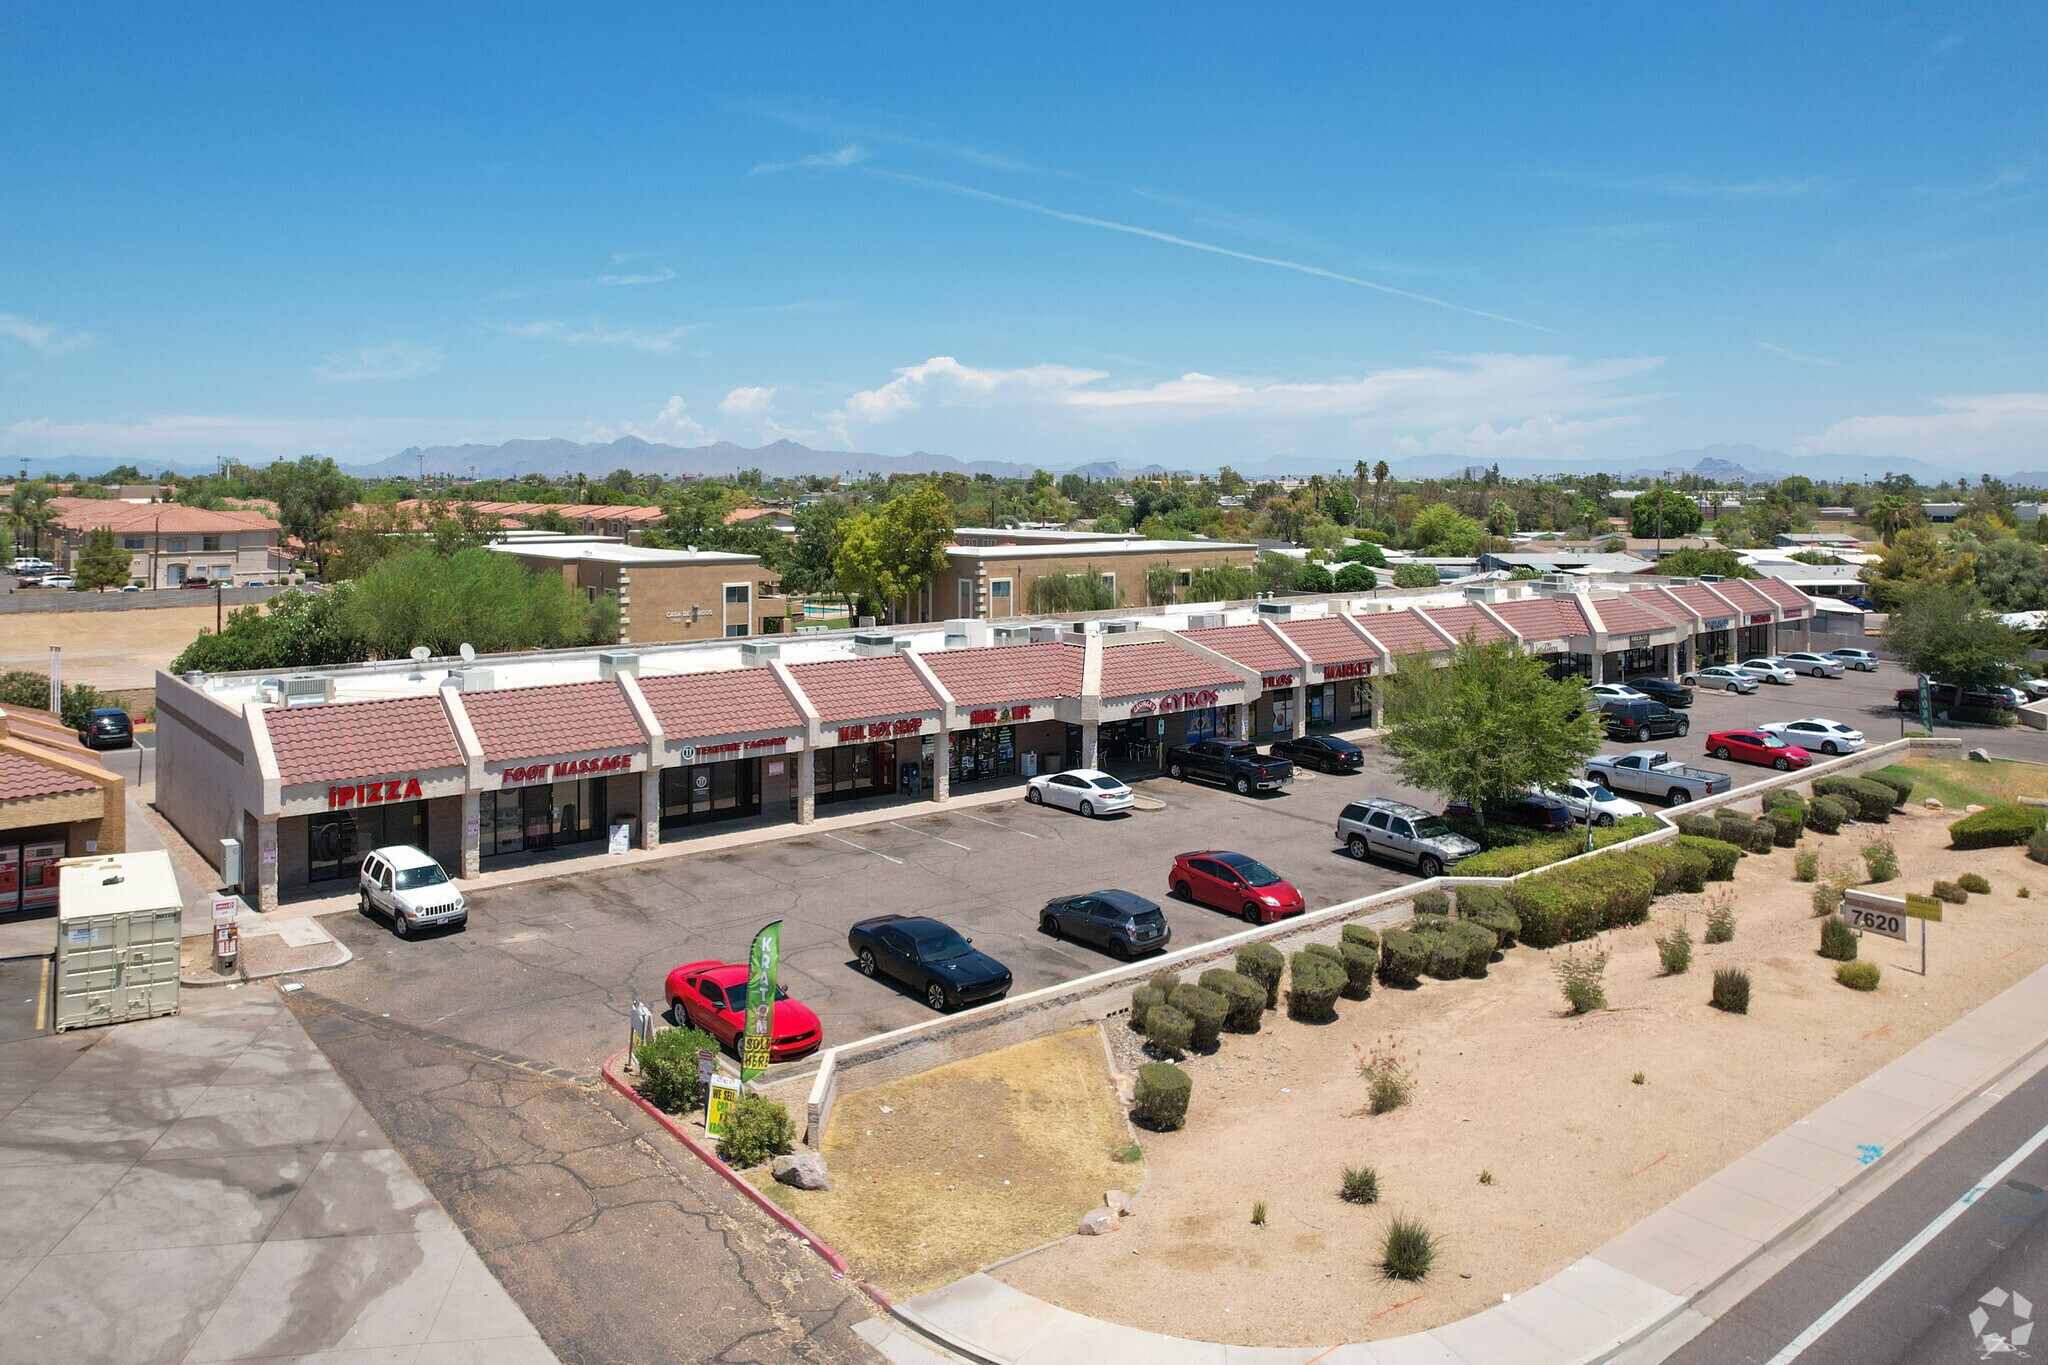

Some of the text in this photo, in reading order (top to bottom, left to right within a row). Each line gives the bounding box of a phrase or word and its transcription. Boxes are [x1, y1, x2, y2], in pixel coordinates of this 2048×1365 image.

[1324, 661, 1374, 680] MARKET
[1160, 688, 1219, 712] GYROS
[970, 705, 1031, 724] SMOKE VAPE
[838, 717, 923, 742] MAIL BOX SHOP
[695, 742, 741, 755] TEXTURE
[743, 736, 788, 749] FACTORY
[502, 754, 632, 783] FOOT MASSAGE
[1908, 895, 1939, 906] AVAILABLE
[1851, 909, 1899, 933] 7620
[754, 936, 772, 1035] KRATOM
[713, 1088, 721, 1100] WE
